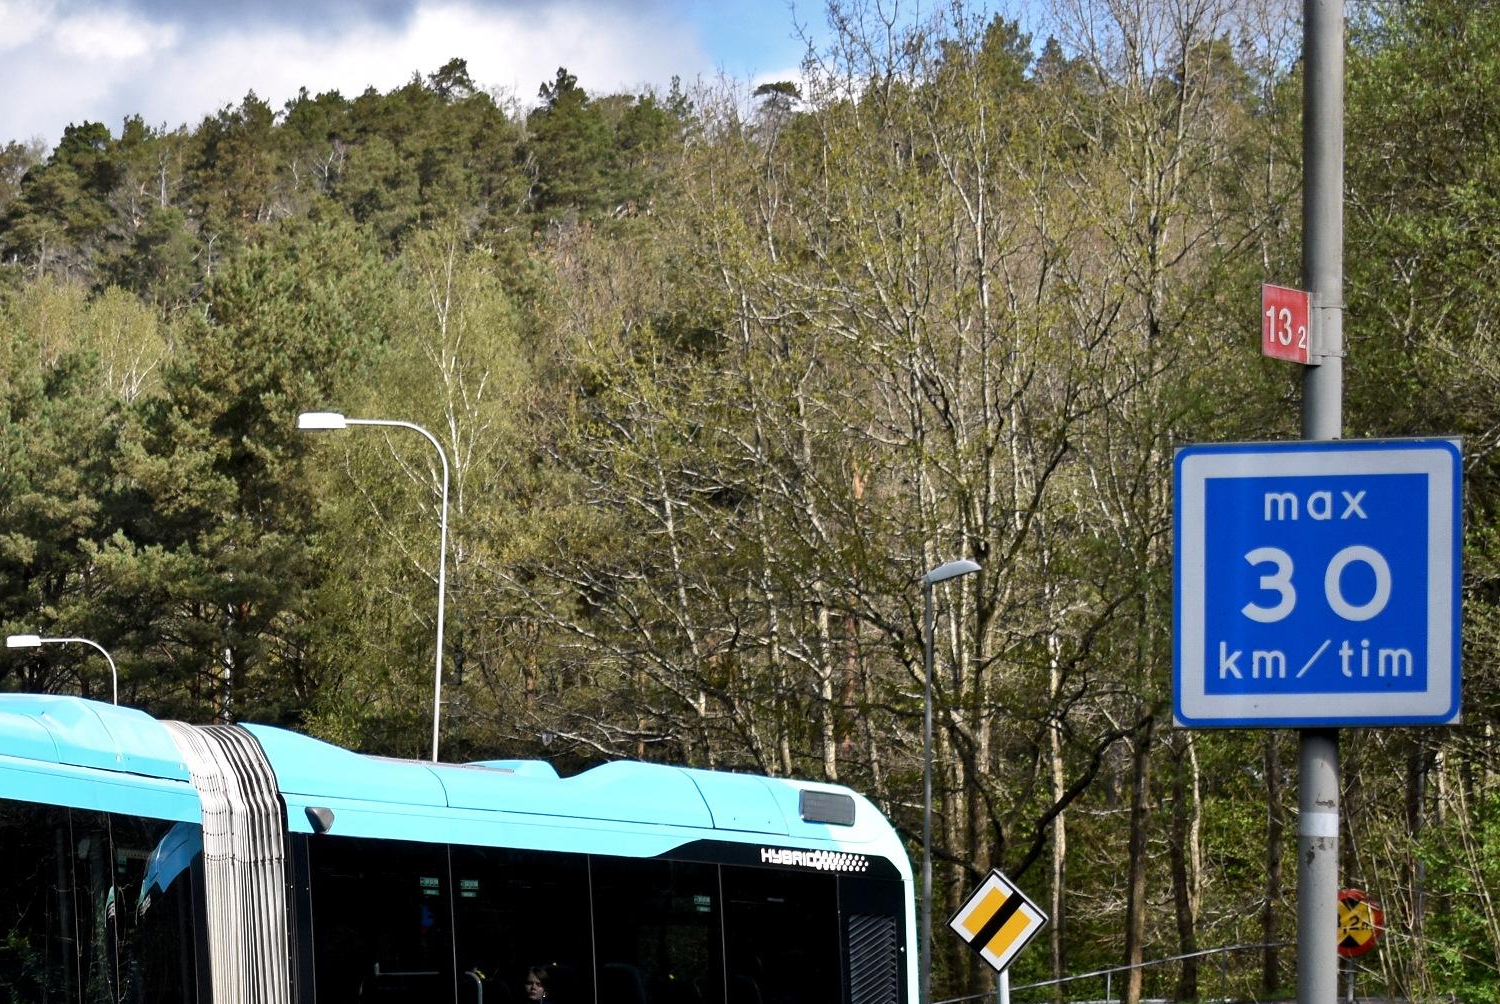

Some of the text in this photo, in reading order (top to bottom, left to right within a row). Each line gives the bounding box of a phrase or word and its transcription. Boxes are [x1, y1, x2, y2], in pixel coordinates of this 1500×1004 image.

[1265, 305, 1292, 346] 13
[1264, 490, 1368, 521] max
[1240, 545, 1392, 623] 30
[1219, 639, 1413, 680] km/tim
[761, 847, 818, 868] HYBRID
